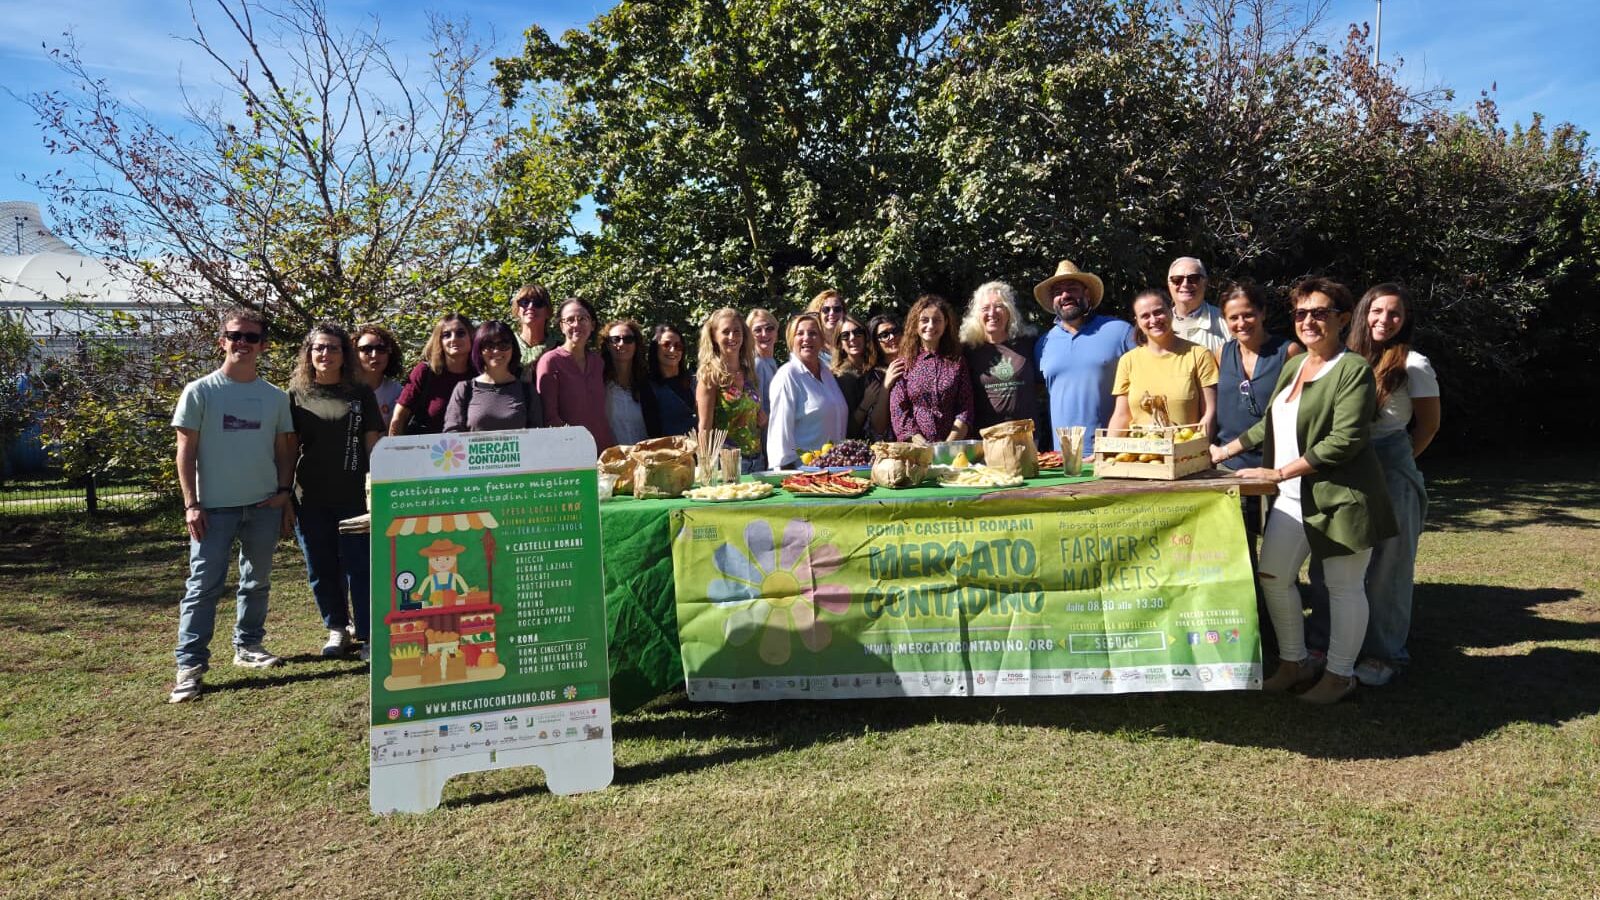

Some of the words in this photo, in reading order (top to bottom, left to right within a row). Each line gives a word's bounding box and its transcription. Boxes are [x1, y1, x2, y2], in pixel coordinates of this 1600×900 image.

[468, 442, 519, 454] MERCATI
[468, 453, 520, 464] CONTADINI
[390, 486, 458, 498] Coltiviamo
[486, 480, 526, 492] futuro
[530, 477, 581, 490] migliore
[392, 496, 456, 509] Contadini
[533, 489, 580, 499] insieme
[866, 524, 905, 536] ROMA
[915, 520, 974, 535] CASTELLI
[980, 518, 1033, 532] ROMANI
[513, 541, 551, 552] CASTELLI
[554, 538, 583, 548] ROMANI
[1060, 534, 1160, 564] FARMER'S
[515, 556, 544, 564] ARICCIA
[869, 538, 1036, 580] MERCATO
[516, 564, 543, 574] ALBANO
[546, 562, 574, 571] LAZIALE
[516, 574, 550, 582] FRASCATI
[1063, 566, 1158, 592] MARKETS
[516, 580, 572, 592] GROTTAFERRATA
[517, 592, 543, 600] PAVONA
[864, 582, 1045, 619] CONTADINO
[517, 600, 544, 608] MARINO
[1066, 603, 1085, 612] dalle
[1088, 600, 1114, 611] 08.30
[1118, 602, 1132, 610] alle
[518, 606, 575, 618] MONTECOMPATRI
[518, 618, 543, 627] ROCCA
[552, 615, 572, 624] PAPA
[517, 634, 539, 644] ROMA
[1094, 636, 1139, 649] SEGUICI
[519, 648, 538, 656] ROMA
[576, 643, 586, 652] EST
[864, 639, 1054, 656] WWW.MERCATOCONTADINO.ORG
[519, 657, 538, 665] ROMA
[520, 666, 538, 674] ROMA
[542, 664, 554, 672] EUR
[558, 660, 588, 670] TORRINO
[425, 690, 556, 714] WWW.MERCATOCONTADINO.ORG
